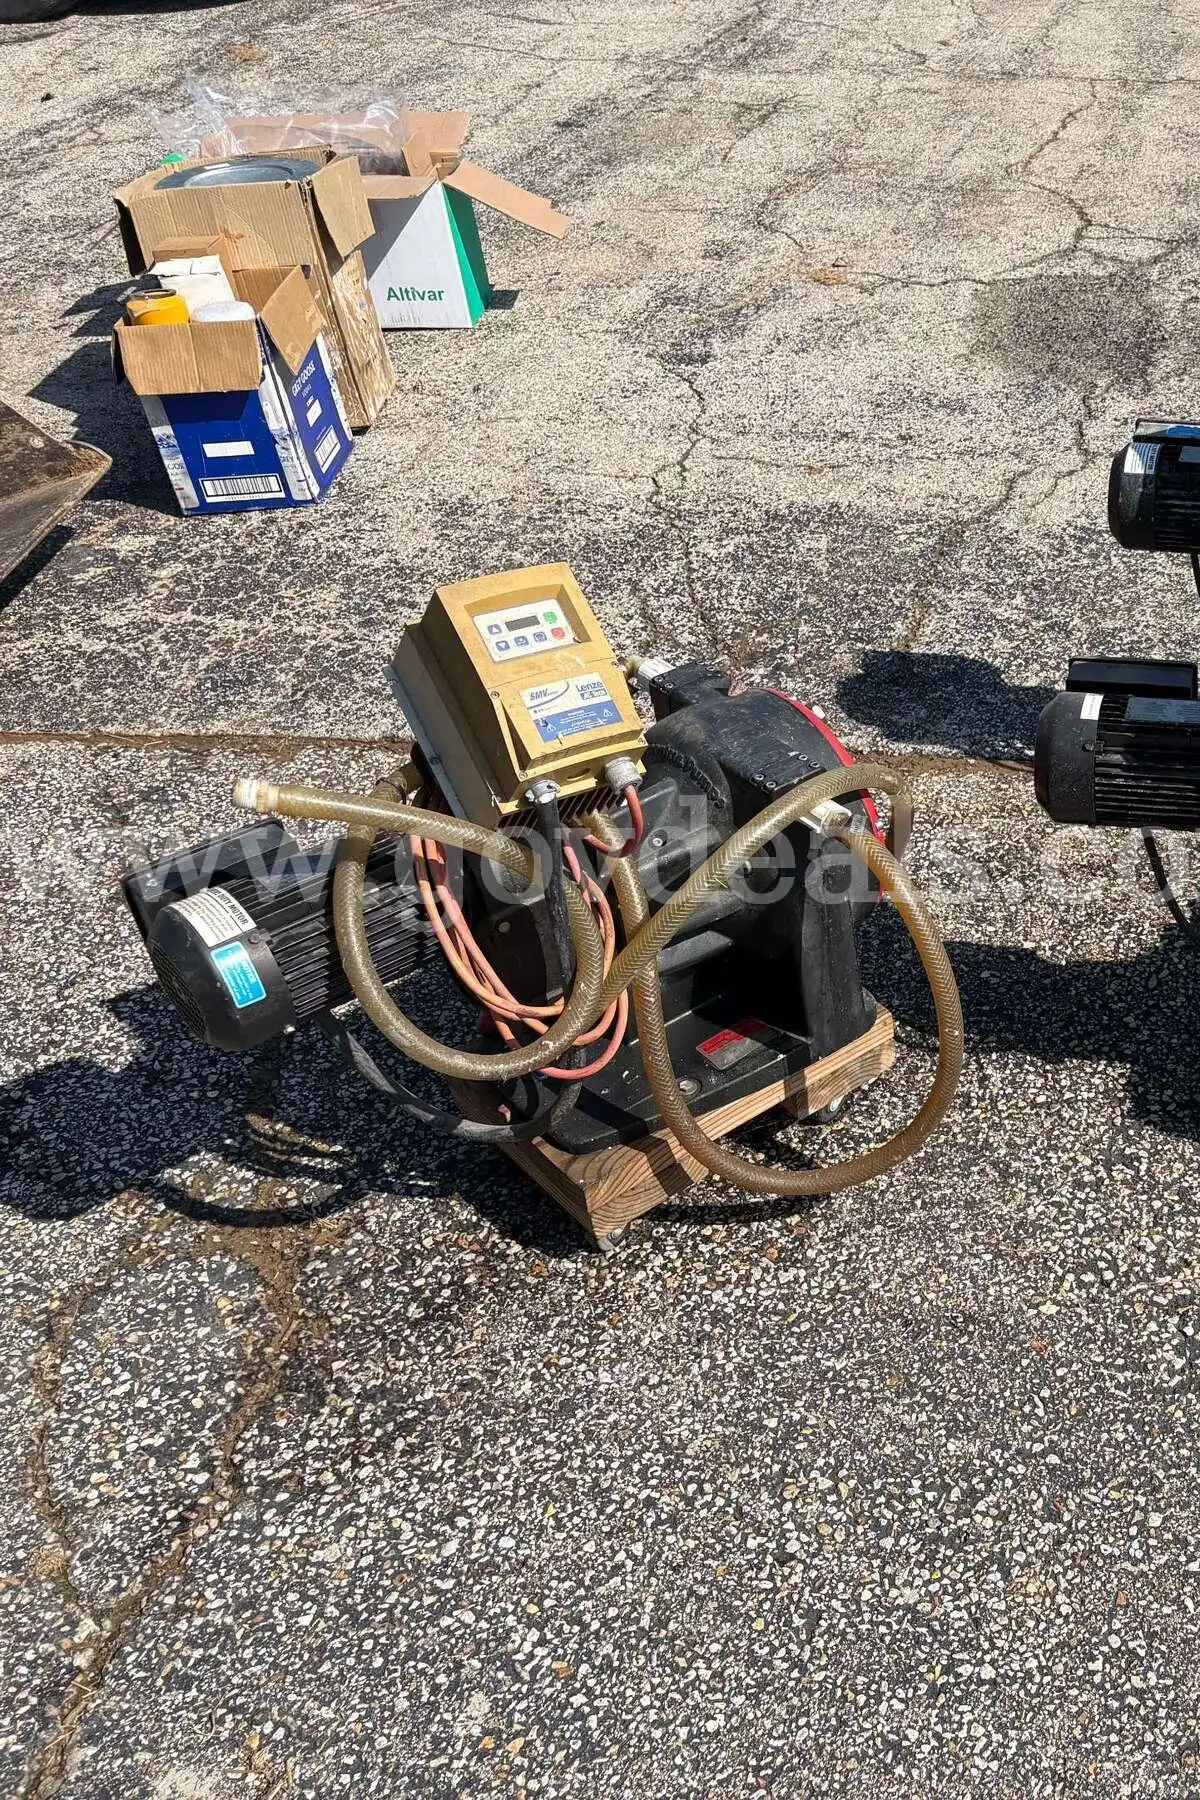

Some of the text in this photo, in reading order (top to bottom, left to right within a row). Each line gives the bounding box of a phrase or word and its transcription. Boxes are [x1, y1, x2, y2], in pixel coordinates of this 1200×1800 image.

[386, 286, 445, 302] Altivar
[575, 680, 604, 692] Lenze
[530, 688, 548, 701] SMV
[227, 902, 248, 925] MOTOR
